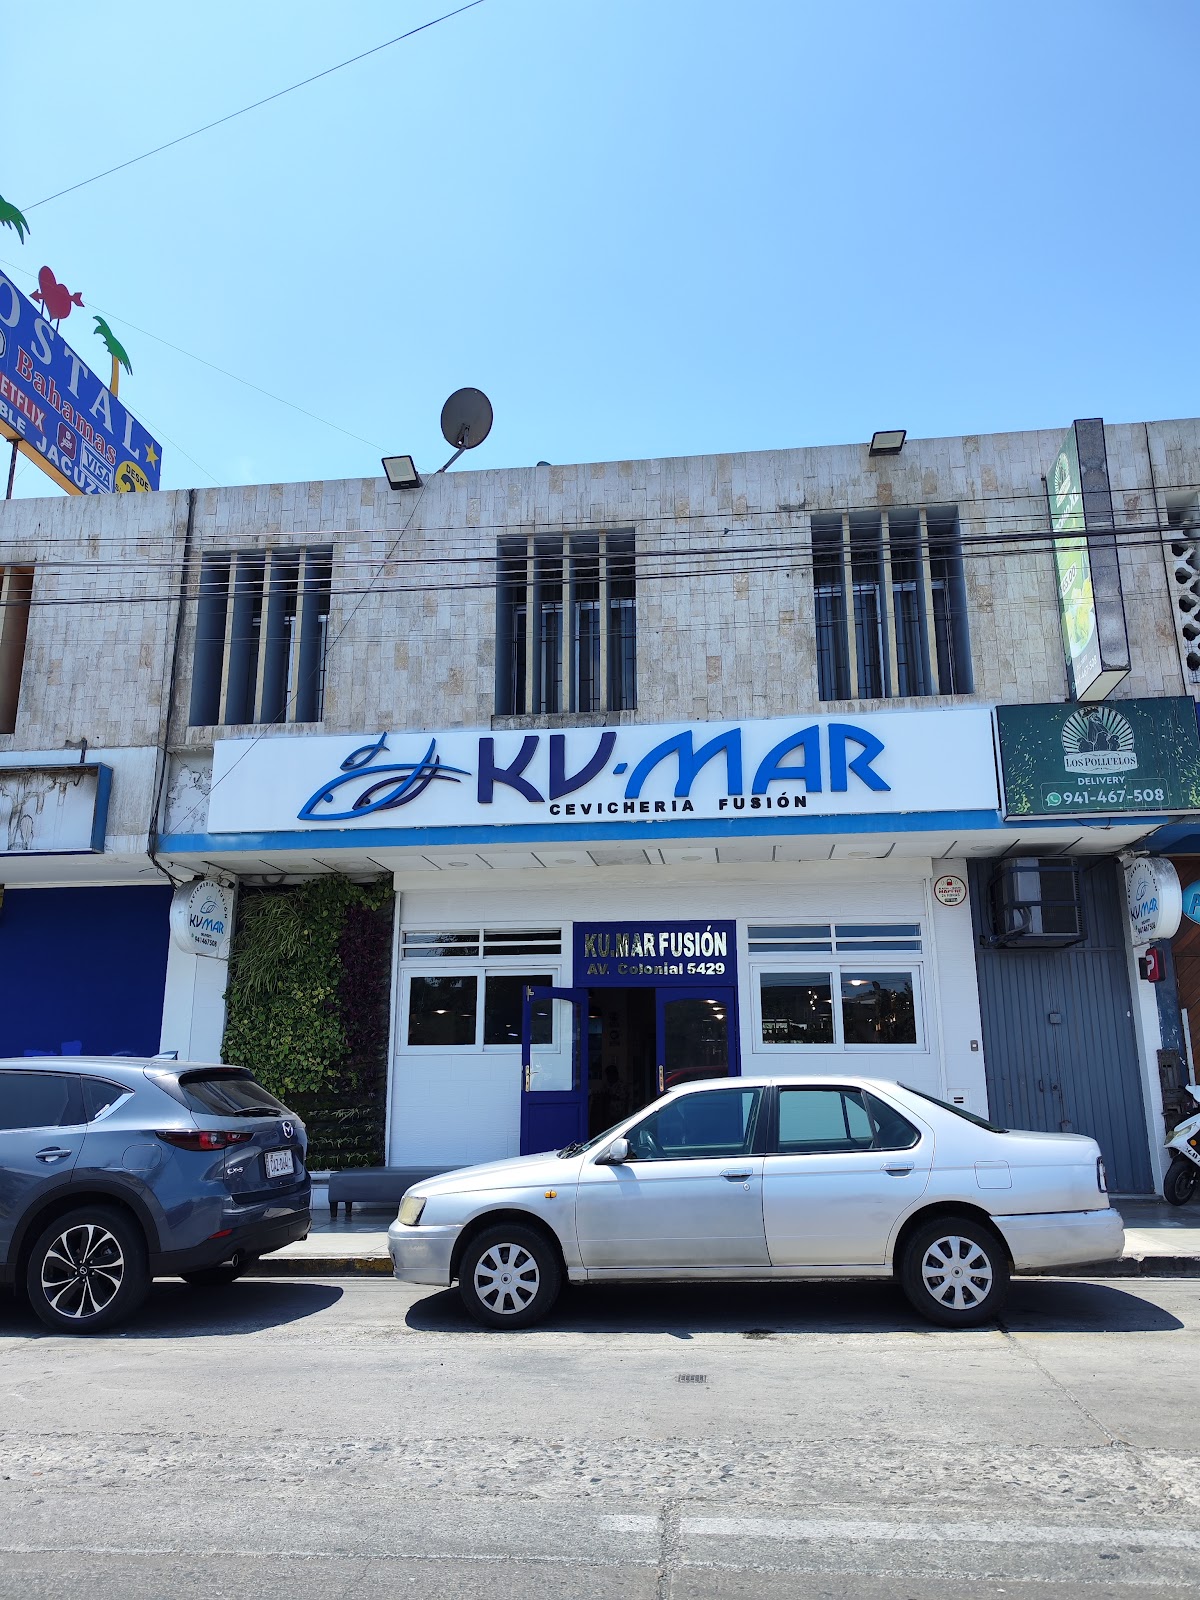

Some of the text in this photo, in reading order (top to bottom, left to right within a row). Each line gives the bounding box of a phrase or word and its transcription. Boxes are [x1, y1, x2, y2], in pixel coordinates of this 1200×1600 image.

[15, 345, 116, 466] Bahamas
[36, 436, 102, 496] JACUZ
[83, 451, 110, 486] VISA
[126, 463, 149, 492] DESDE
[1066, 756, 1136, 768] LOS POLLUELOS
[1077, 775, 1126, 786] DELIVERY
[718, 792, 808, 810] FUSIÓN
[1063, 788, 1165, 805] 941-467-508
[550, 800, 695, 816] CEVICHERIA
[658, 925, 727, 958] FUSIÓN
[617, 962, 683, 975] Colonial
[686, 962, 726, 975] 5429
[227, 1166, 244, 1175] CX-5
